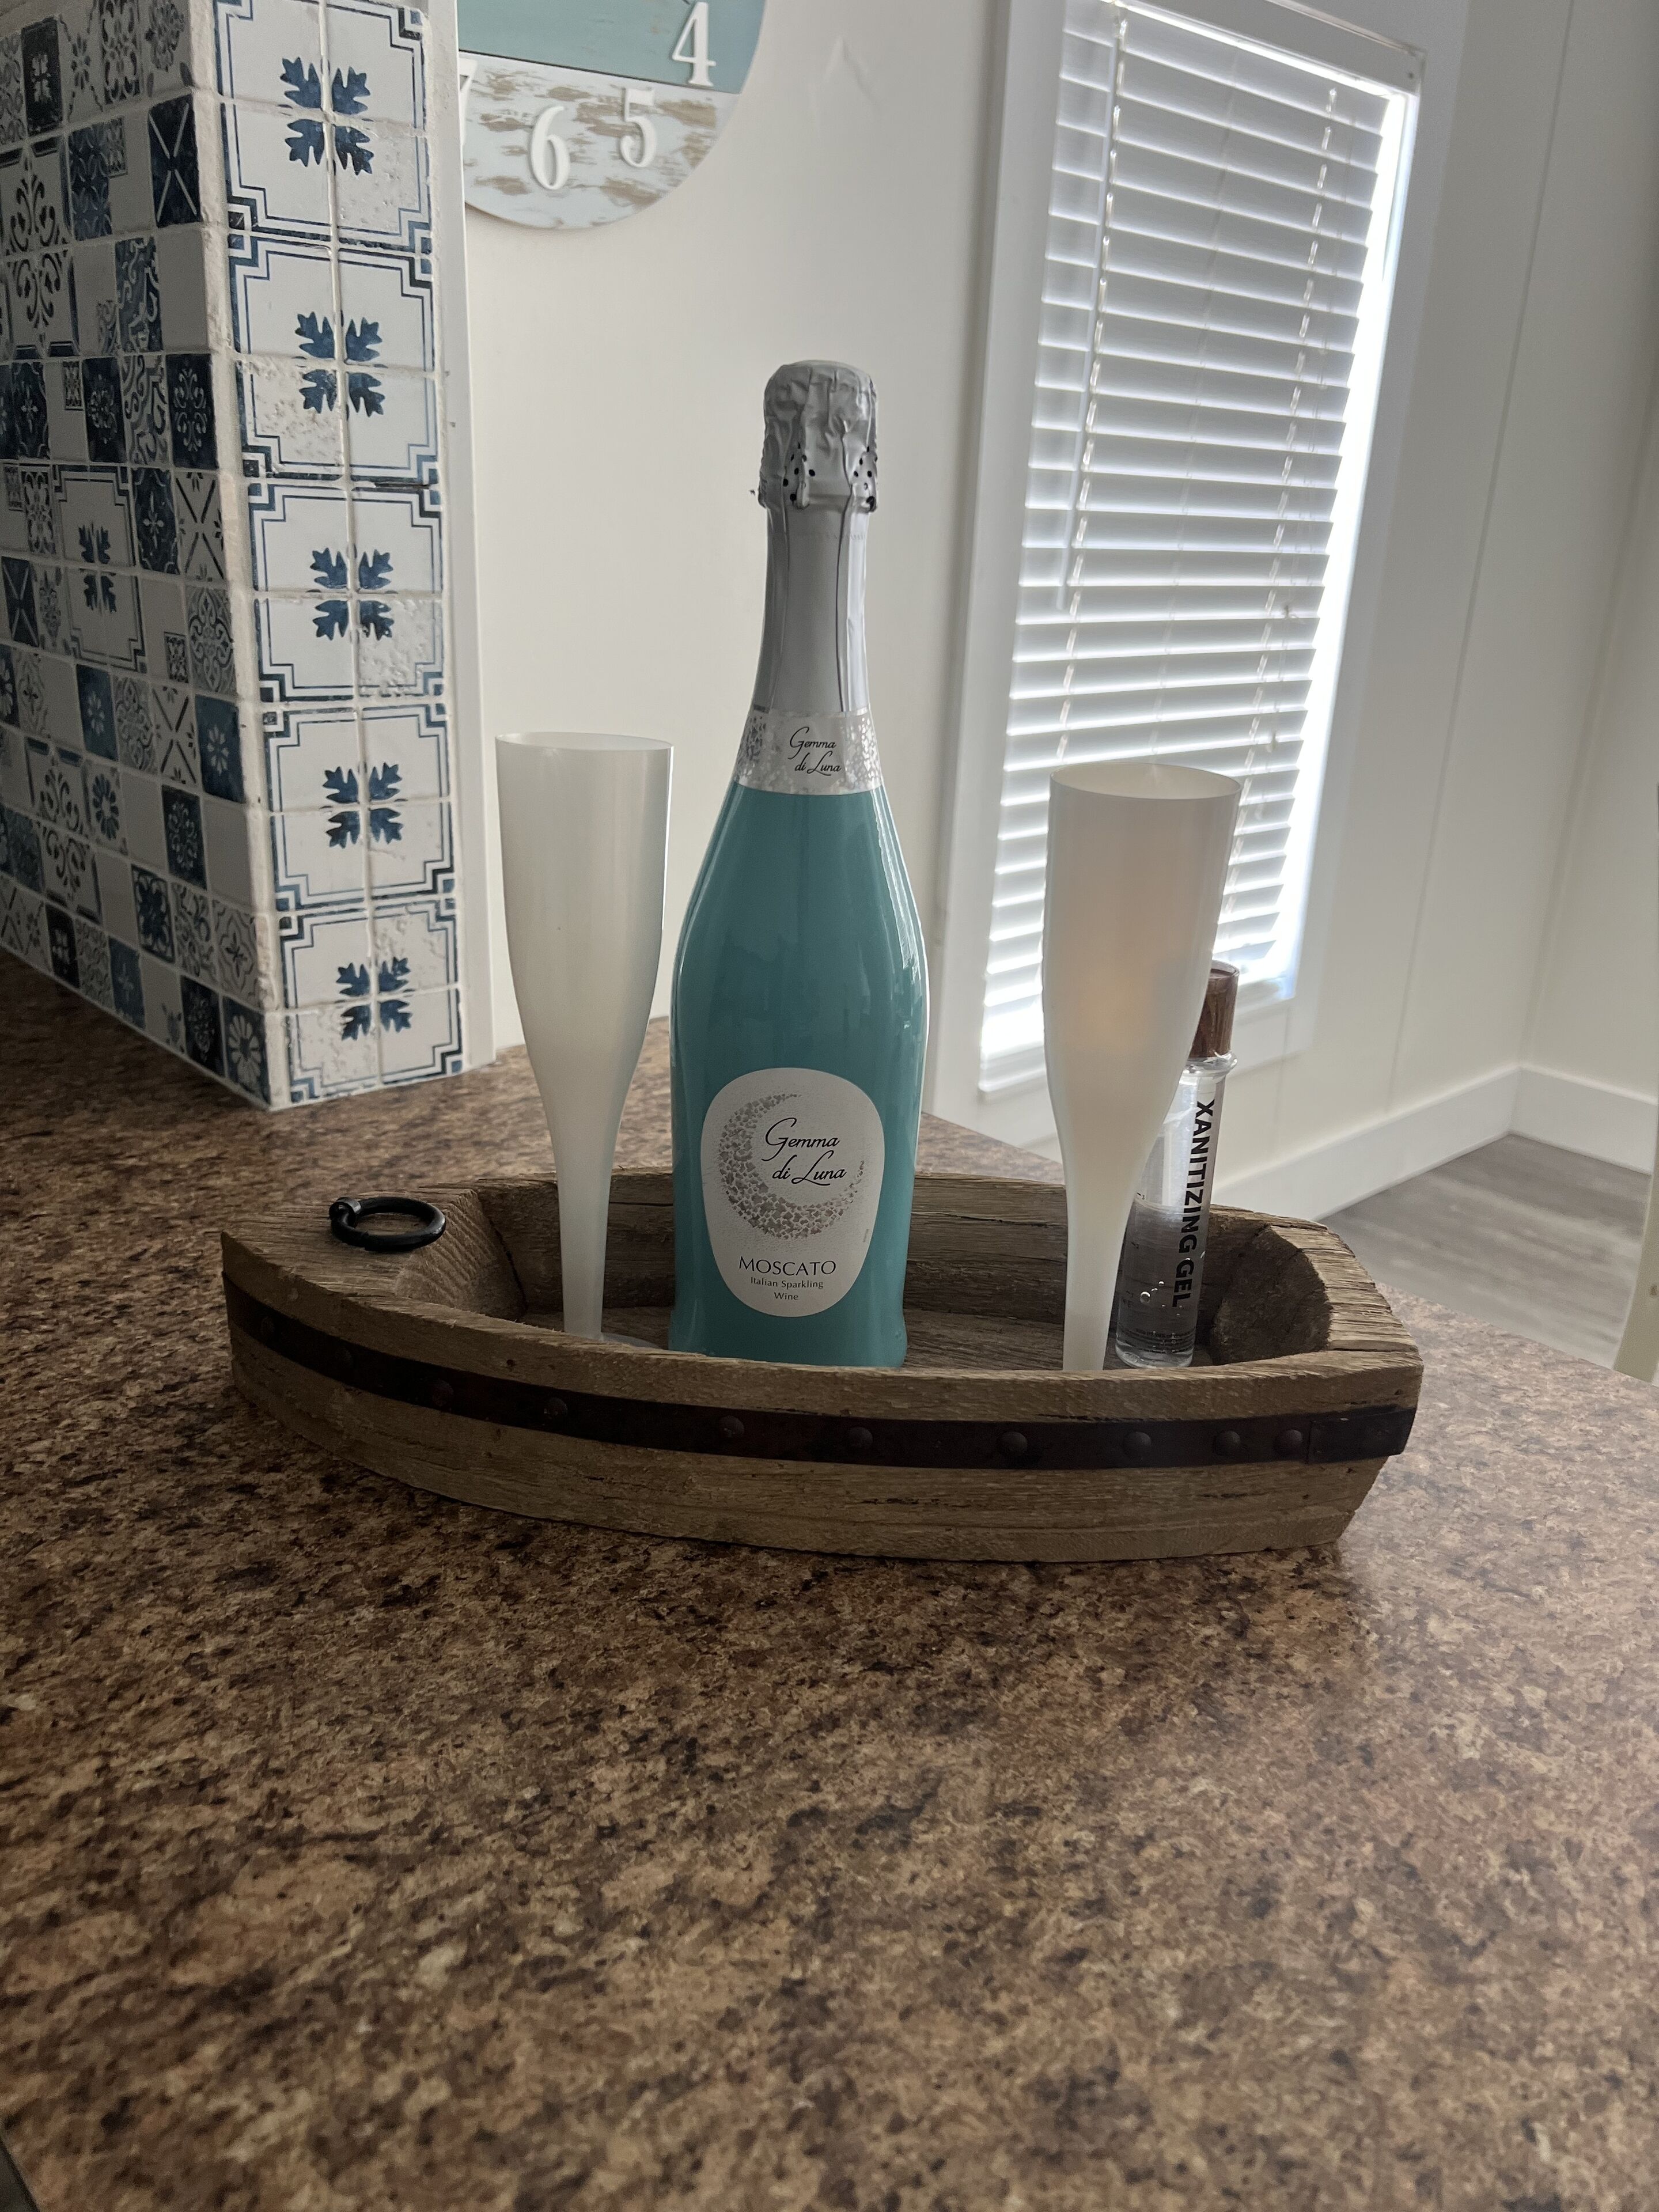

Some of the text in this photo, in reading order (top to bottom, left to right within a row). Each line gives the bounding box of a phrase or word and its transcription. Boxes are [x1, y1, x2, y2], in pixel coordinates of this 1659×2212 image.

[672, 1, 716, 86] 4
[620, 88, 657, 167] 5
[530, 106, 570, 190] 6
[787, 726, 836, 759] Gemma
[794, 751, 842, 776] di Luna
[761, 1118, 840, 1161] Gemma
[772, 1150, 847, 1186] di Luna
[1172, 1100, 1215, 1307] XANITIZING GEL
[738, 1256, 836, 1276] MOSCATO
[750, 1276, 824, 1289] Italian Sparkling
[774, 1292, 799, 1300] Wine
